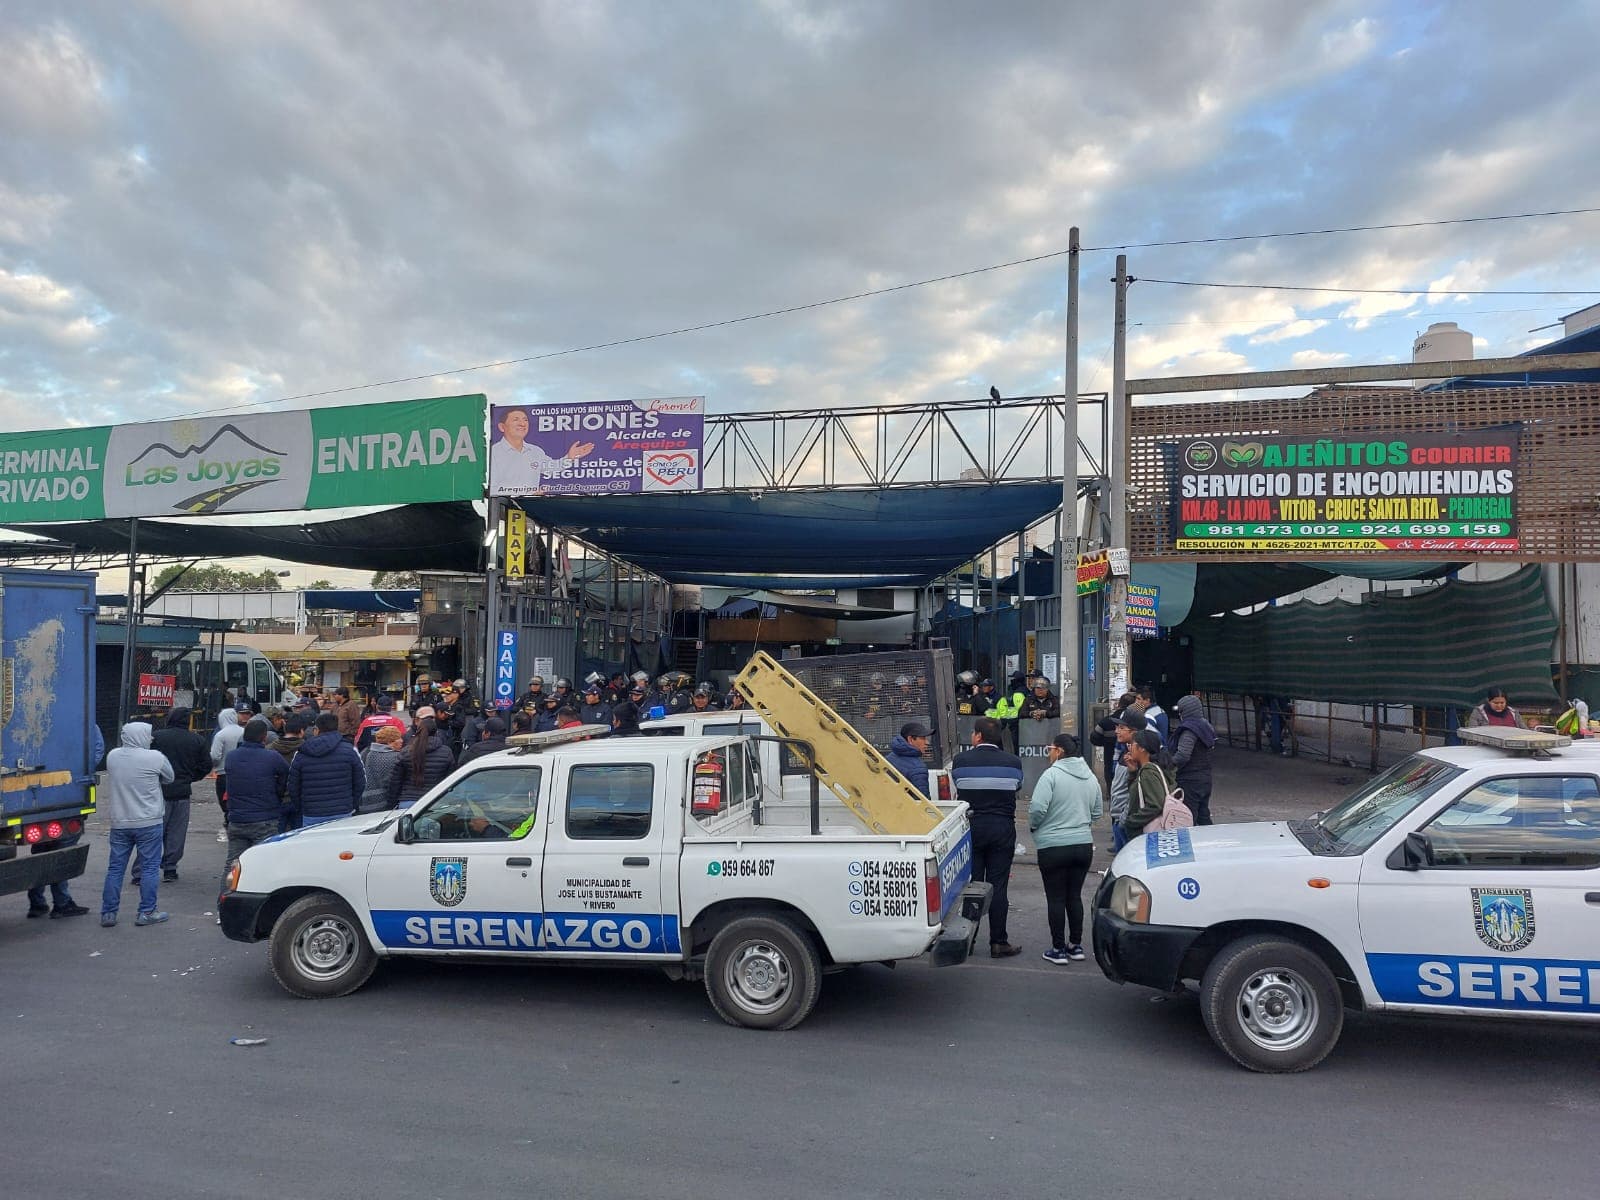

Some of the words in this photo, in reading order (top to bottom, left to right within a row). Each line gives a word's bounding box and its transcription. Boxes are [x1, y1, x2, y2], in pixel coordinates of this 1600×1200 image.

[531, 408, 546, 416] CON
[547, 407, 560, 415] LOS
[560, 406, 587, 414] HUEVOS
[588, 405, 603, 413] BIEN
[604, 404, 633, 412] PUESTOS
[648, 399, 697, 411] Coronel
[538, 410, 659, 432] BRIONES
[606, 430, 666, 441] Alcalde
[671, 428, 692, 437] de
[318, 425, 477, 475] ENTRADA
[611, 440, 688, 452] Arequipa
[581, 458, 618, 468] sabe
[623, 457, 642, 467] de
[1411, 446, 1511, 465] COURIER
[125, 464, 179, 487] Las
[187, 454, 281, 485] Joyas
[543, 467, 642, 479] SEGURIDAD!
[1181, 473, 1291, 498] SERVICIO
[1297, 472, 1327, 496] DE
[1332, 469, 1514, 496] ENCOMIENDAS
[1243, 499, 1271, 521] JOYA
[1279, 499, 1316, 521] VITOR
[1325, 498, 1366, 520] CRUCE
[1368, 498, 1408, 520] SANTA
[1410, 498, 1440, 520] RITA
[1448, 497, 1513, 519] PEDREGAL
[1208, 525, 1245, 535] 981
[1253, 525, 1292, 535] 473
[1300, 525, 1339, 535] 002
[1360, 525, 1402, 535] 924
[1409, 524, 1451, 535] 699
[1459, 524, 1501, 535] 158
[510, 512, 522, 576] PLAYA
[1179, 540, 1245, 549] RESOLUCIÓN
[1266, 541, 1376, 549] 4626-2021-MTC/17.02
[721, 859, 738, 877] 959
[740, 859, 757, 877] 664
[758, 859, 775, 877] 867
[863, 860, 880, 878] 054
[882, 861, 917, 879] 426666
[566, 879, 620, 888] MUNICIPALIDAD
[621, 879, 632, 888] DE
[863, 880, 880, 897] 054
[883, 880, 918, 898] 568016
[1180, 881, 1197, 895] 03
[558, 889, 576, 898] JOSE
[577, 889, 593, 899] LUIS
[594, 890, 643, 899] BUSTAMANTE
[583, 901, 588, 909] Y
[590, 901, 616, 910] RIVERO
[864, 899, 881, 917] 054
[884, 899, 918, 917] 568017
[405, 915, 651, 949] SERENAZGO
